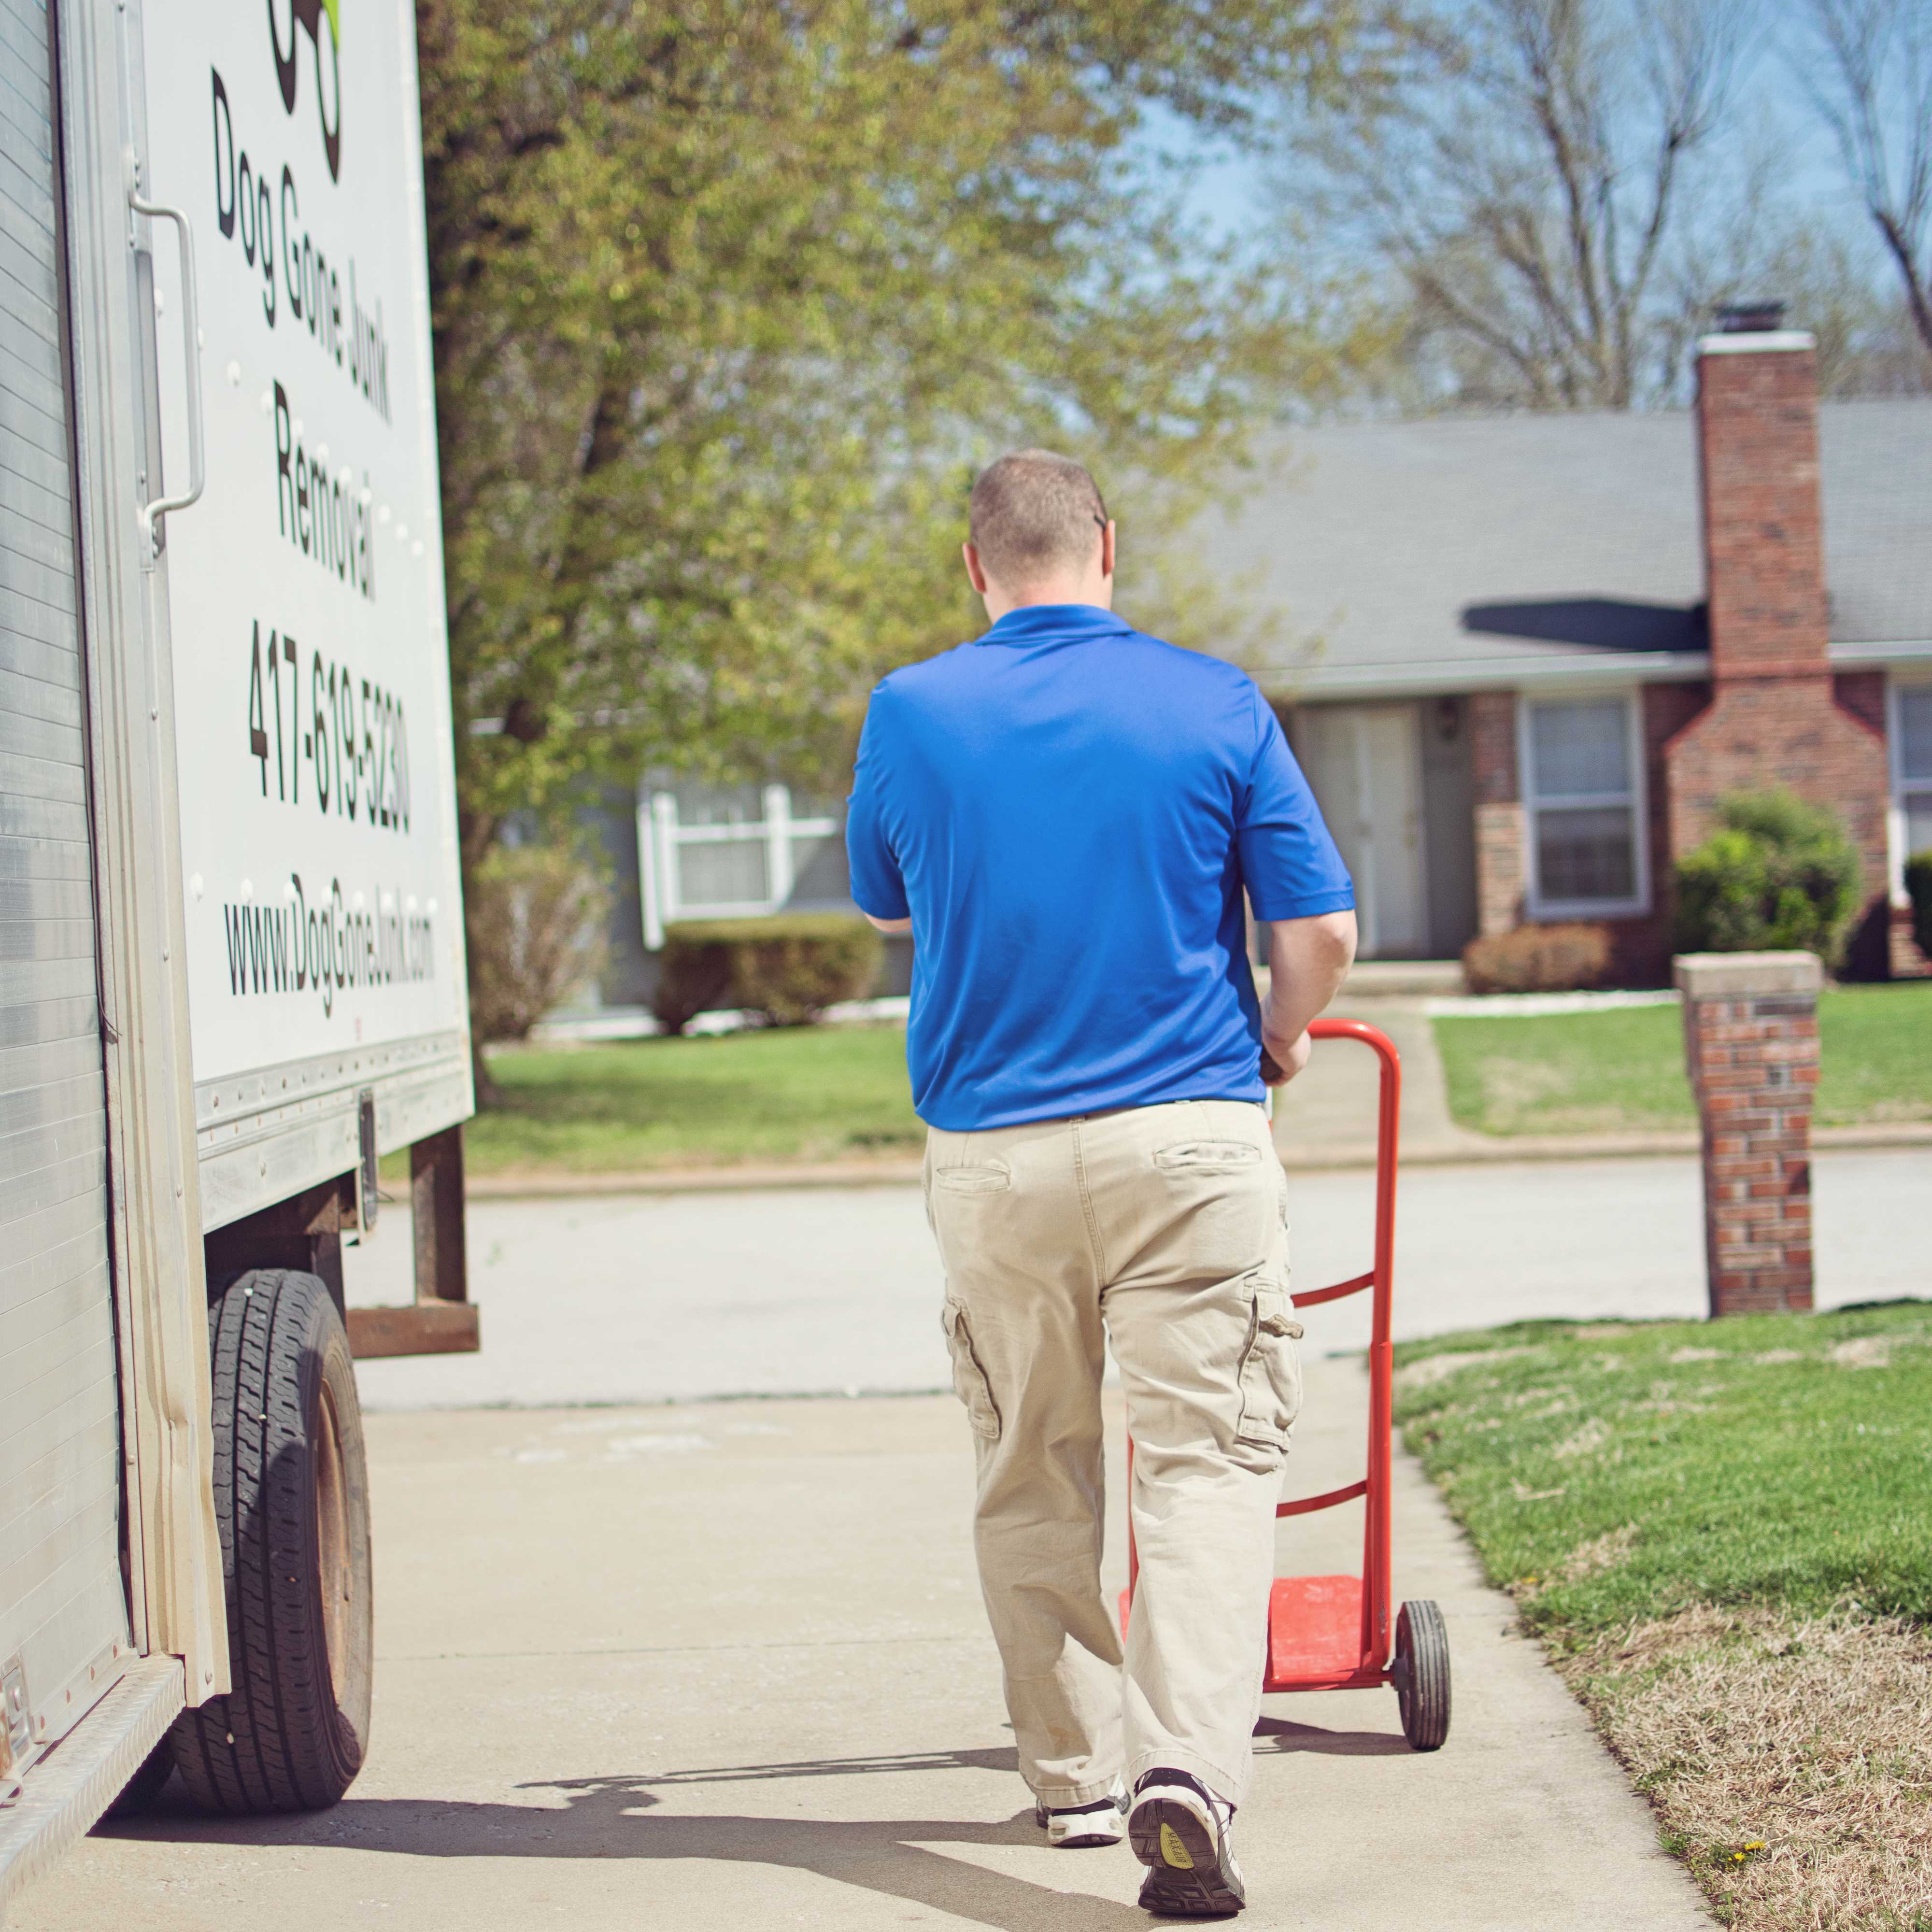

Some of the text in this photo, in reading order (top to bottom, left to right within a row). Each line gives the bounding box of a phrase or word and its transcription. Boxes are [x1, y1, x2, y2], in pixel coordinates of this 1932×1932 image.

[211, 64, 391, 426] Dog Gone Junk
[273, 379, 374, 604] Removal
[250, 618, 409, 835] 417-619-5230
